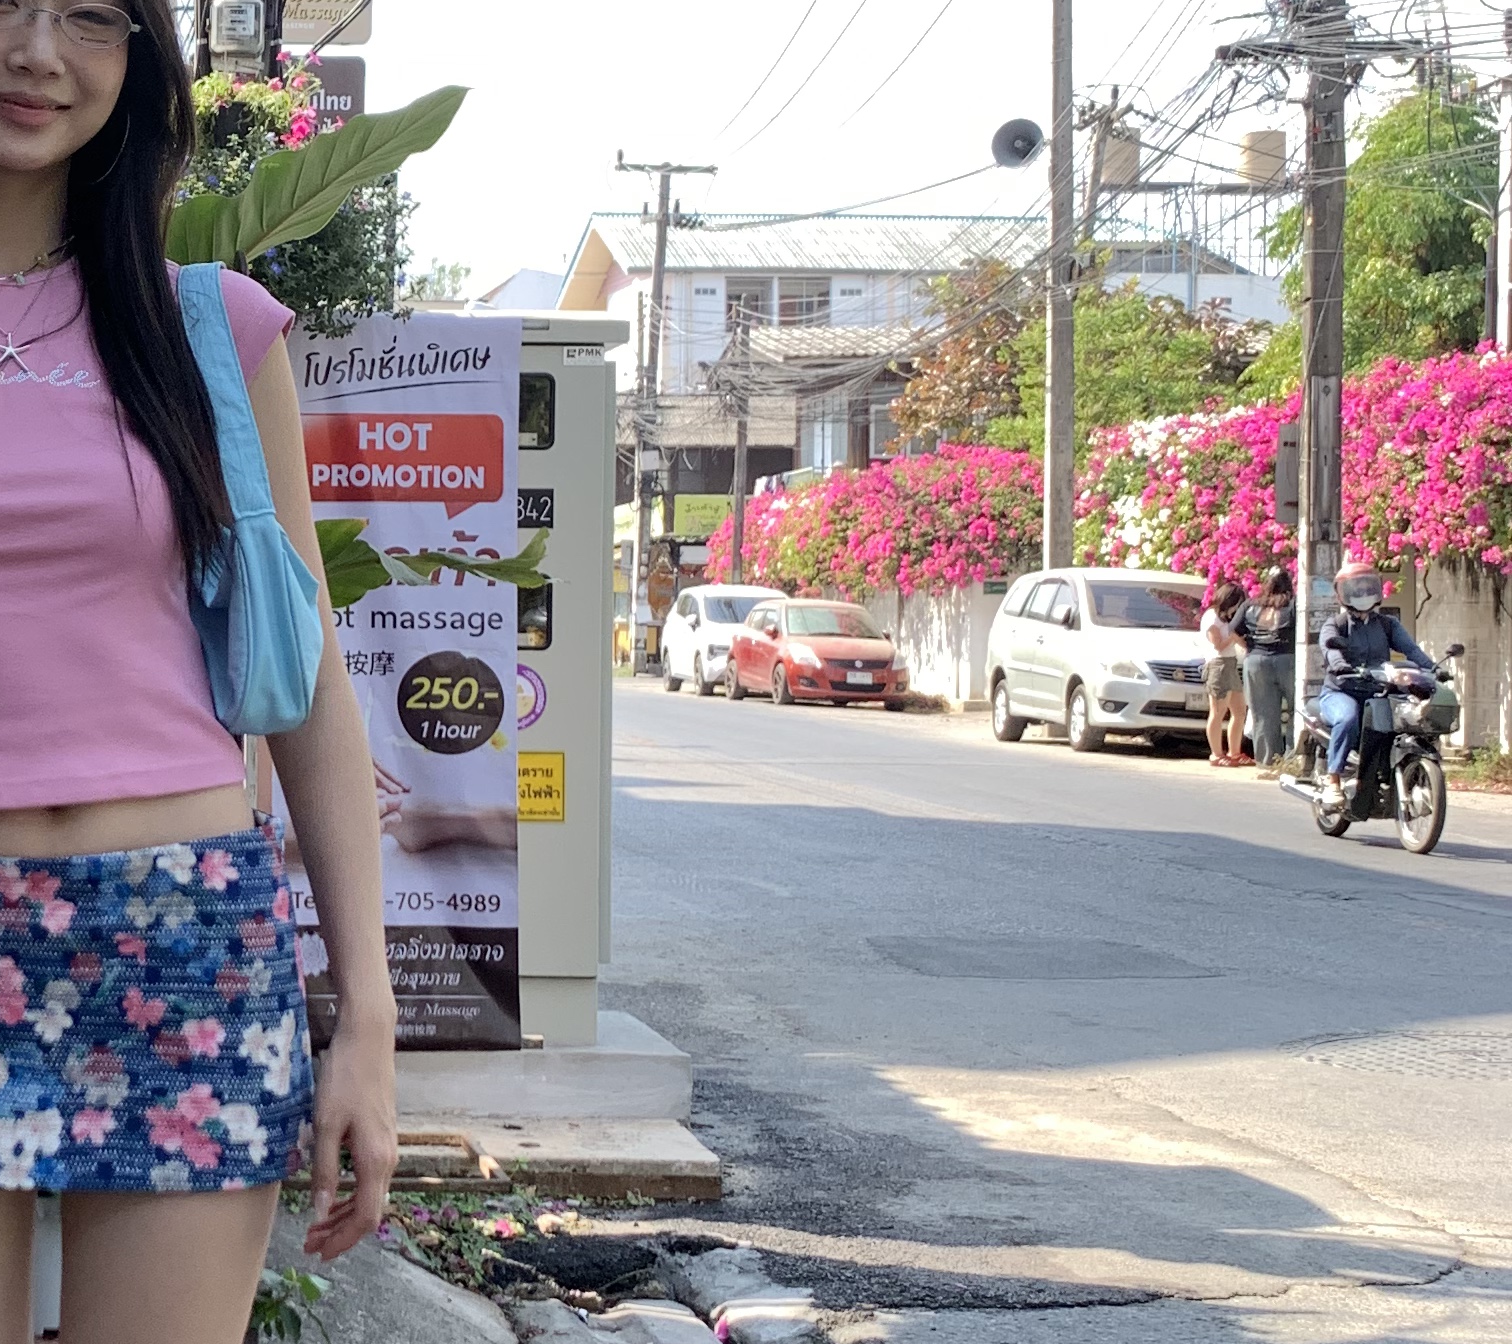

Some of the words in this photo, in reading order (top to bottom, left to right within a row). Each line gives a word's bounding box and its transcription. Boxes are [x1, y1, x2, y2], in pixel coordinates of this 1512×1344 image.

[304, 336, 491, 389] โปรโมชั่นพิเศษ
[577, 348, 602, 357] PMK
[358, 422, 432, 451] HOT
[311, 464, 484, 489] PROMOTION
[371, 609, 503, 637] massage
[405, 676, 498, 710] 250.-
[421, 721, 430, 738] 1
[434, 720, 481, 739] hour
[386, 892, 501, 912] -705-4989
